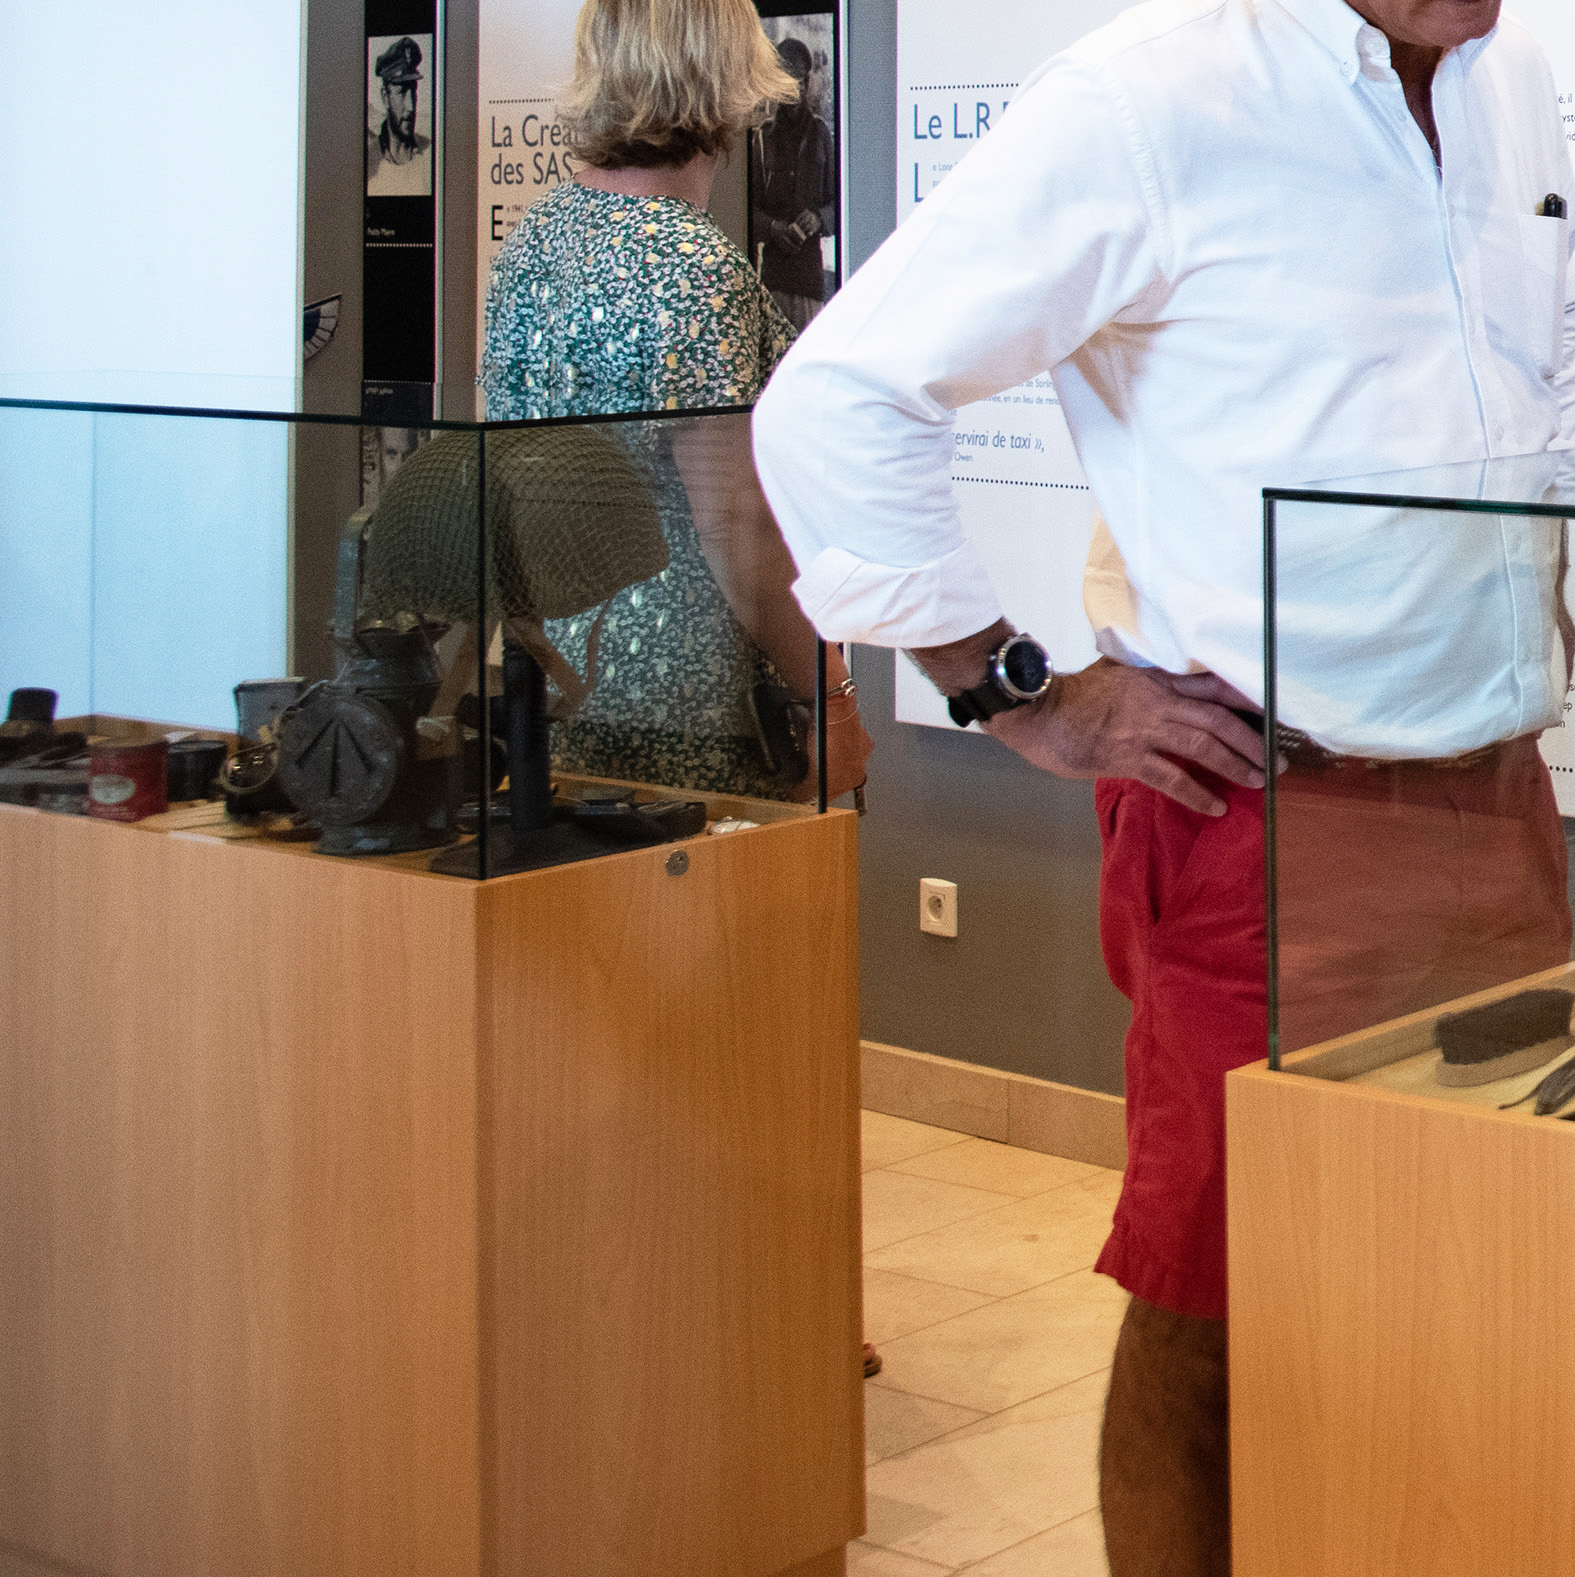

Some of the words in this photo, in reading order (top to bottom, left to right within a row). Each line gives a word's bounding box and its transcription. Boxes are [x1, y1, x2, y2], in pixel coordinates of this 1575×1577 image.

[492, 116, 512, 148] La
[914, 103, 942, 140] Le
[491, 153, 524, 184] des
[955, 428, 990, 447] ervirai
[992, 429, 1007, 448] de
[1010, 432, 1032, 449] taxi
